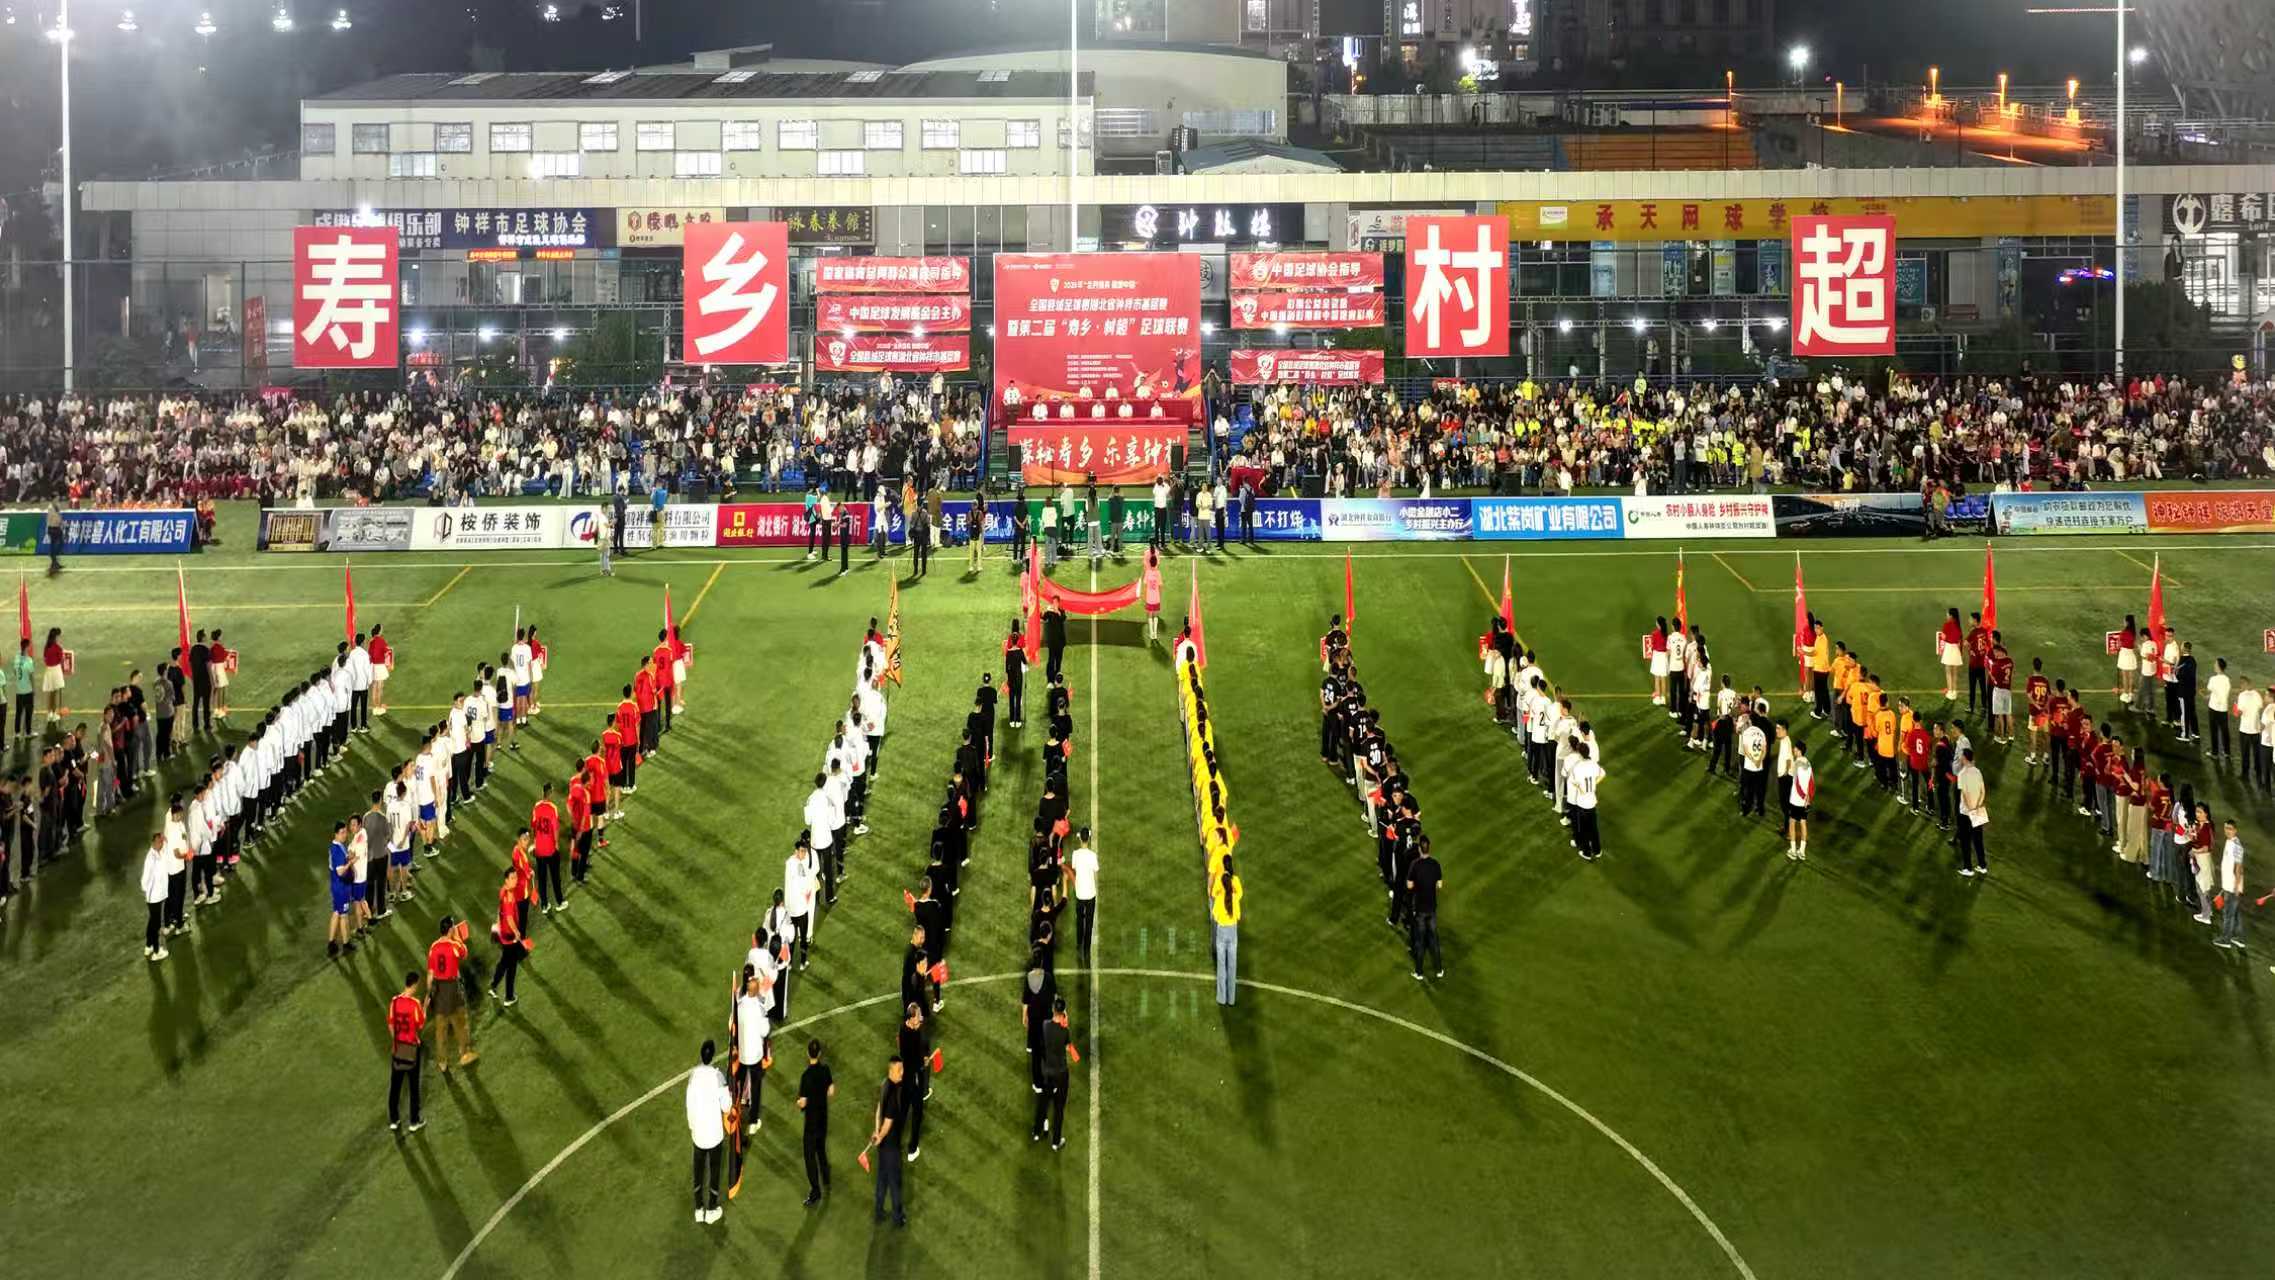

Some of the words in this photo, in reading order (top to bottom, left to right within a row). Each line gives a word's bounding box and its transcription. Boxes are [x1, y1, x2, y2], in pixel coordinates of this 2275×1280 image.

[454, 211, 587, 234] 钟祥市足球协会
[1271, 261, 1361, 277] 中国足球协会指导
[695, 232, 778, 355] 乡
[1411, 224, 1503, 349] 村
[1798, 224, 1890, 346] 超
[300, 234, 392, 359] 寿
[756, 514, 788, 537] 湖北银行
[1539, 711, 1545, 727] 2
[1369, 749, 1381, 766] 30
[1915, 739, 1923, 754] 6
[1584, 776, 1593, 792] 11
[437, 953, 447, 974] 8
